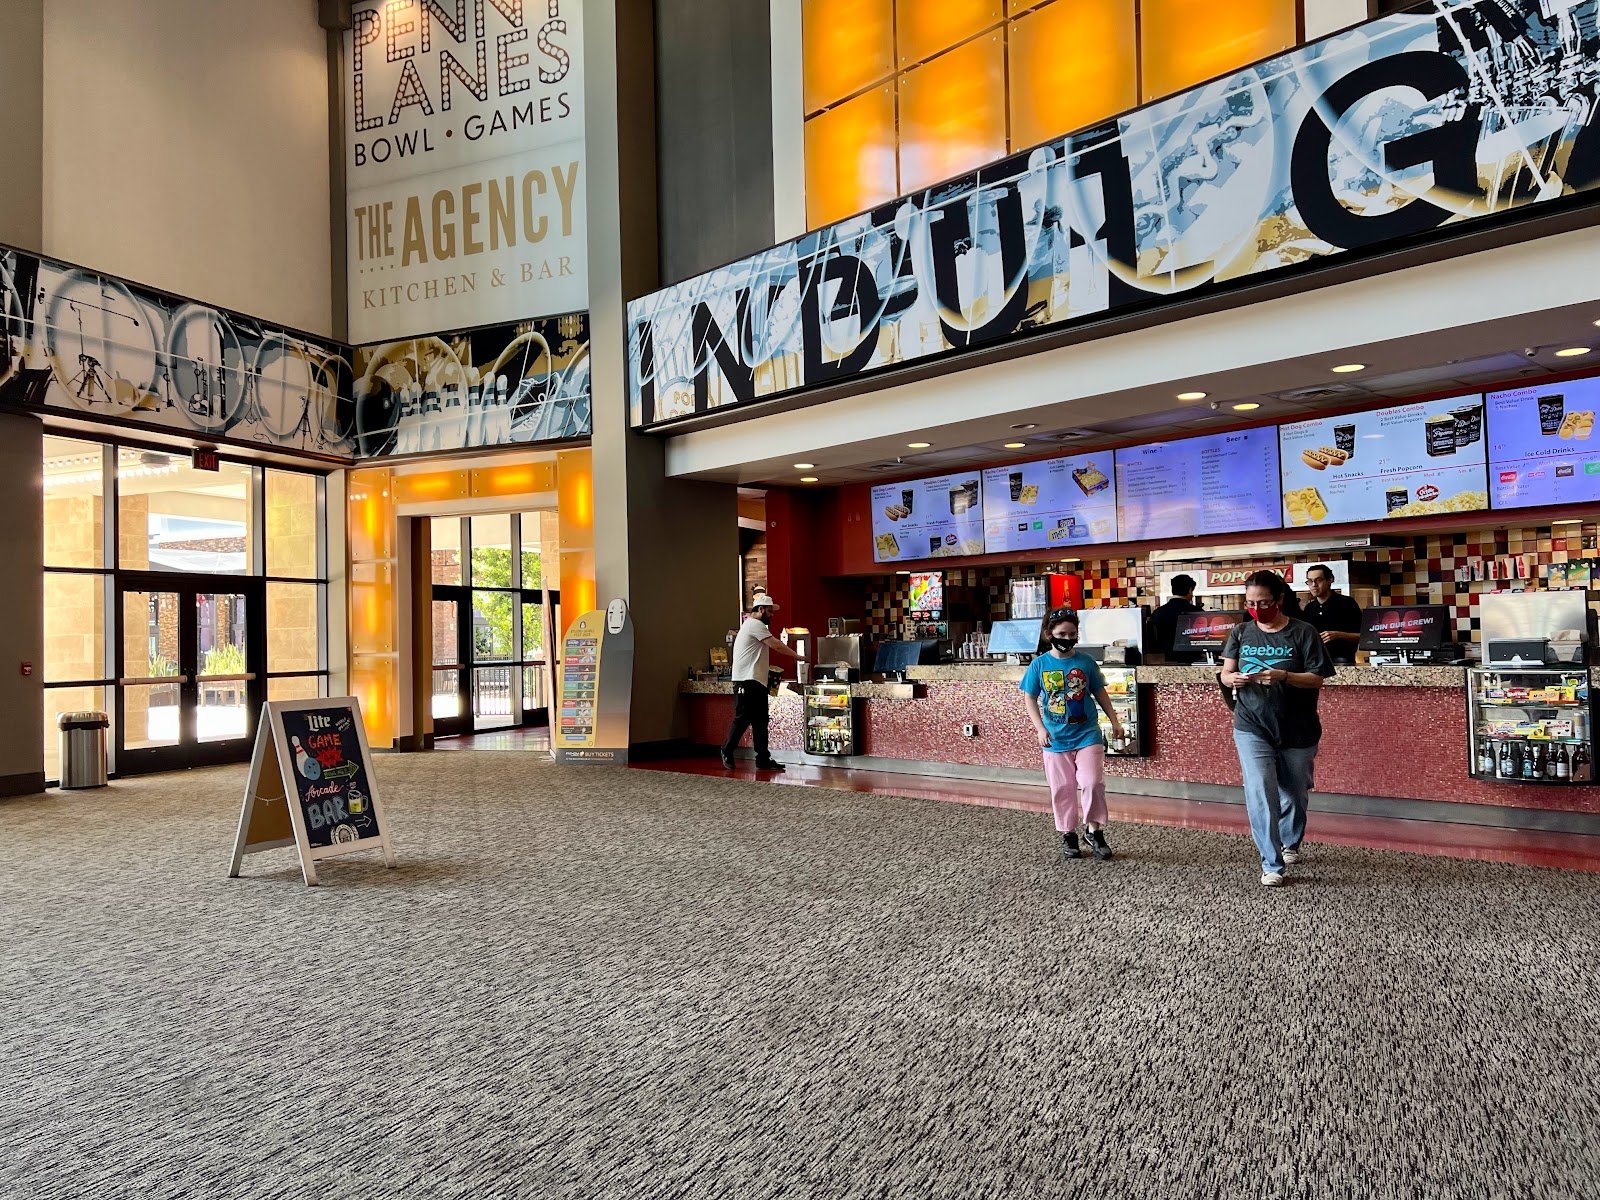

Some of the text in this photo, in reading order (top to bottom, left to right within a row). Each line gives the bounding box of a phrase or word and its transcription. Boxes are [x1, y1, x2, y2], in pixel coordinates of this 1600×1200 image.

[353, 0, 559, 71] PENN
[355, 20, 570, 132] LANES
[355, 92, 571, 166] BOWL GAMES
[354, 161, 579, 267] THE AGENCY
[363, 256, 573, 309] KITCHEN & BAR
[1490, 388, 1537, 400] Nacho Combo
[1376, 405, 1425, 417] Doubles Combo
[1291, 423, 1302, 431] Dog
[1535, 448, 1551, 456] Cold
[1552, 446, 1575, 454] Drinks
[199, 452, 216, 469] EXIT
[1398, 464, 1423, 473] Popcorn
[1344, 471, 1364, 479] Snacks
[1210, 567, 1288, 584] POPCN
[1182, 622, 1236, 636] JOIN OUR CREW!
[1369, 616, 1434, 632] JOIN OUR CREW!
[1241, 644, 1294, 657] Reebok
[307, 715, 331, 732] Lite
[308, 733, 342, 749] GAME
[304, 780, 344, 802] Arcade
[307, 796, 349, 831] BAR
